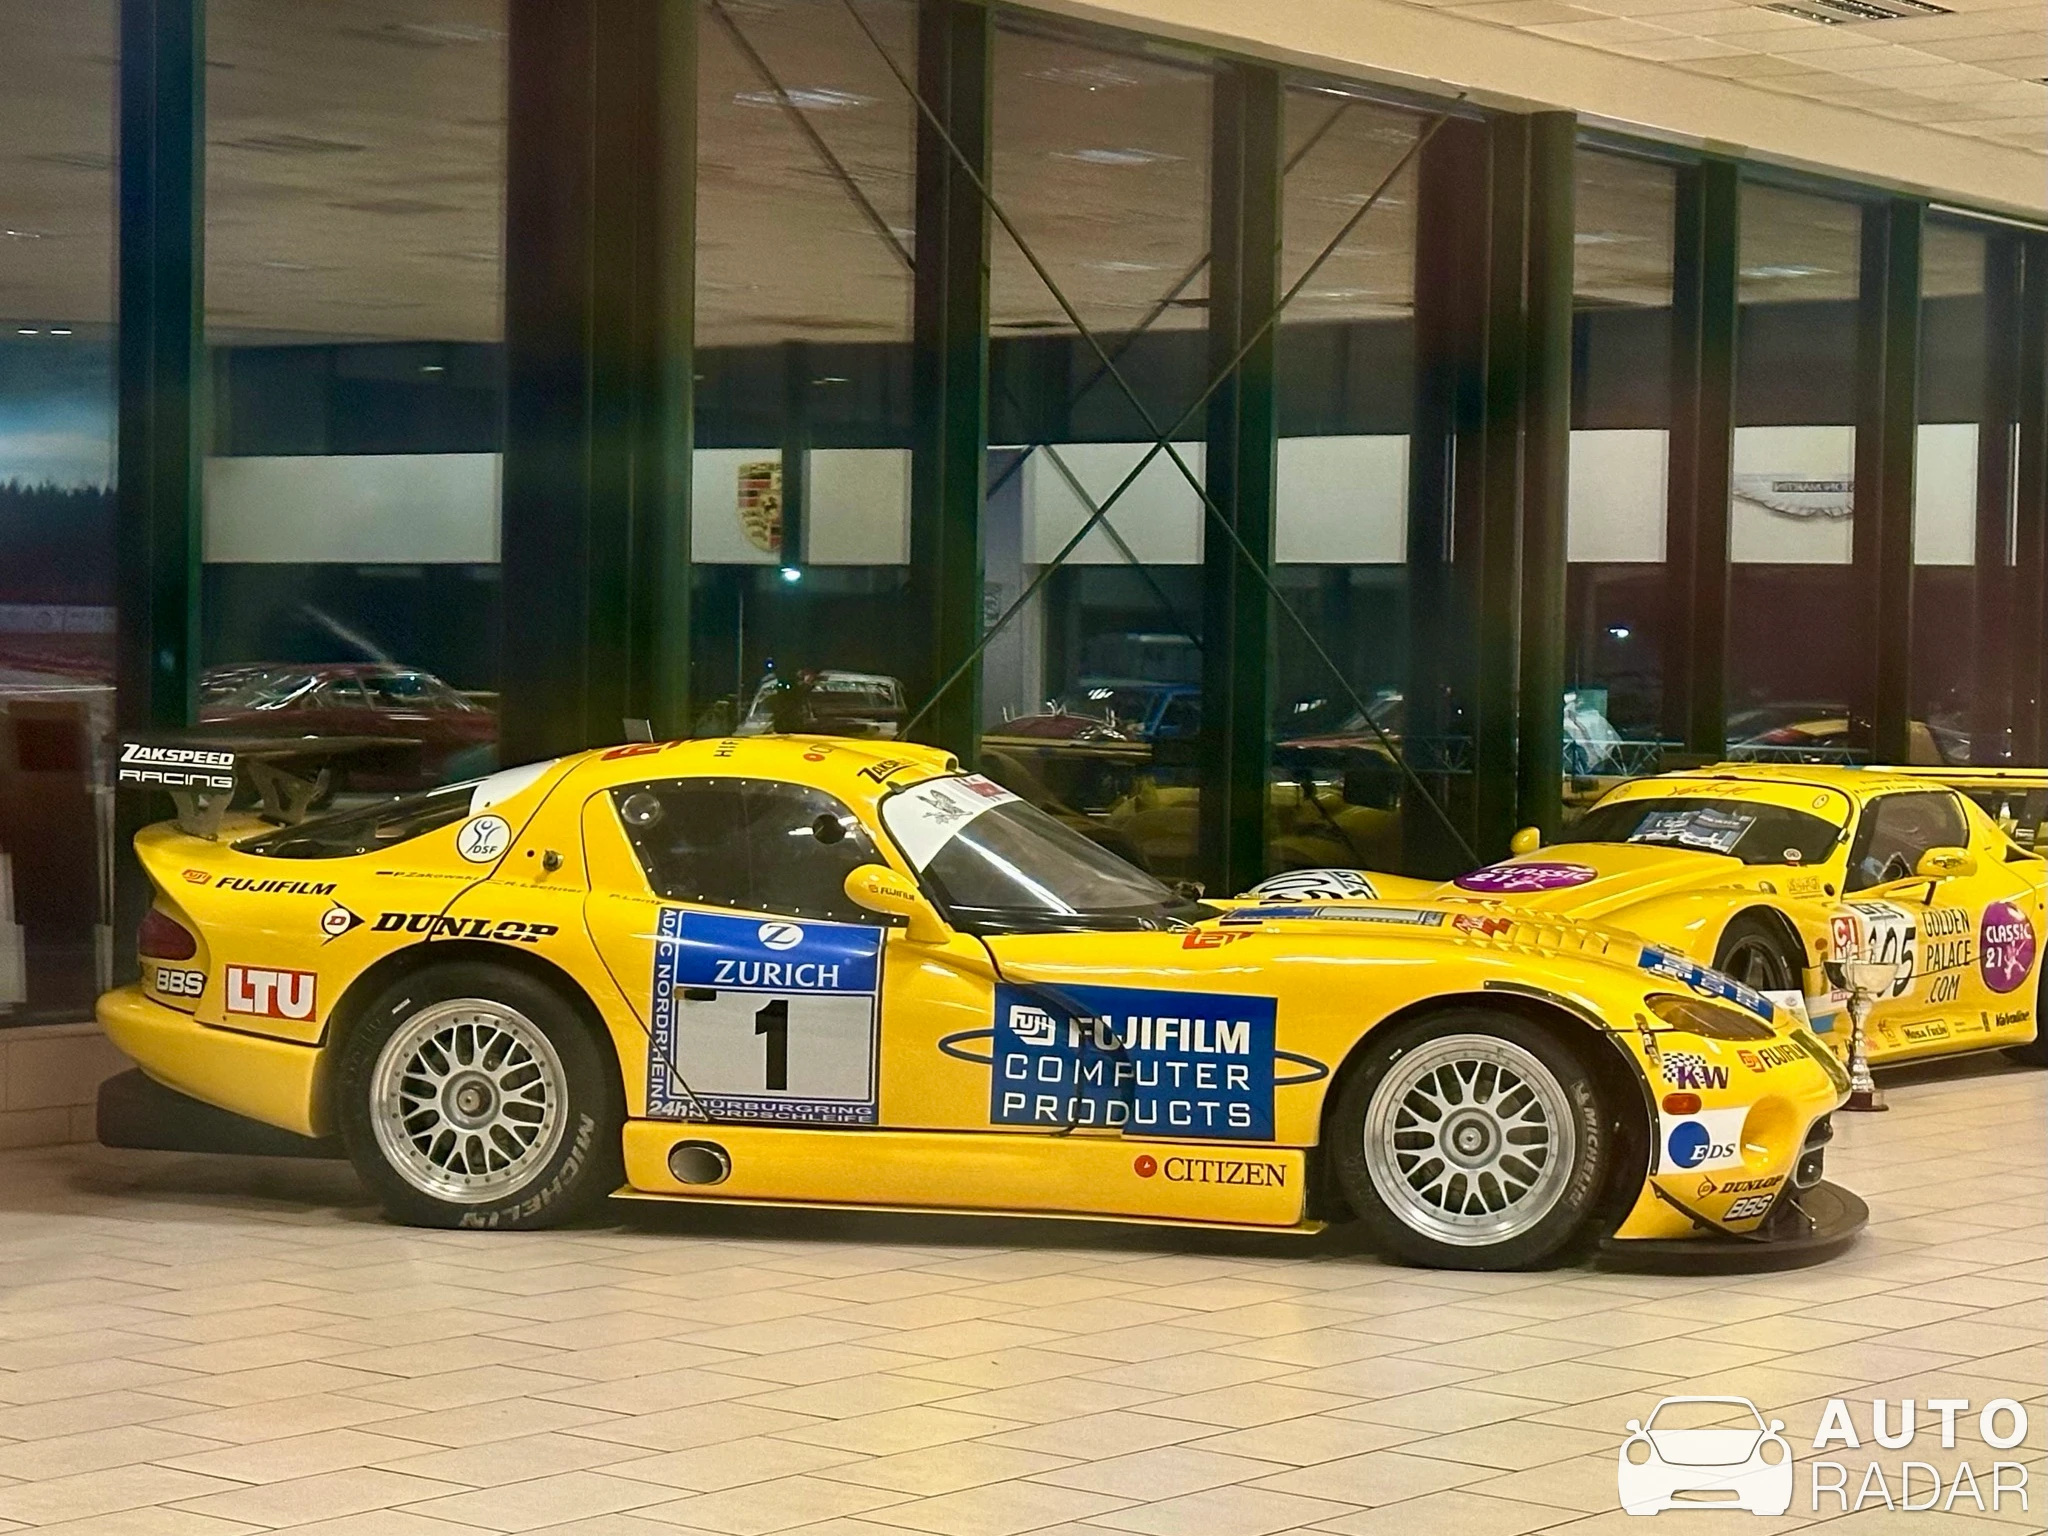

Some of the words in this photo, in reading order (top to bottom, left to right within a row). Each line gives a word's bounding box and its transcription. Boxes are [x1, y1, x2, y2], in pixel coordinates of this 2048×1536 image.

[121, 743, 235, 768] ZAKSPEED
[119, 769, 233, 788] RACING
[472, 845, 498, 854] DSF
[215, 877, 337, 895] FUJIFILM
[371, 912, 559, 943] DUNLOP
[659, 908, 677, 957] ADAC
[1921, 908, 1970, 938] GOLDEN
[1986, 922, 2032, 943] CLASSIC
[1926, 940, 1971, 972] PALACE
[1985, 947, 2003, 968] 21
[156, 969, 204, 996] BBS
[714, 959, 840, 988] ZURICH
[227, 967, 315, 1018] LTU
[1925, 974, 1960, 1004] .COM
[651, 964, 672, 1099] NORDRHEIN
[755, 1000, 788, 1091] 1
[1068, 1015, 1250, 1055] FUJIFILM
[1004, 1053, 1252, 1091] COMPUTER
[1677, 1065, 1729, 1090] KW
[648, 1100, 688, 1118] 24h
[689, 1099, 872, 1116] NÜRBURGRING
[688, 1108, 872, 1123] NORDSCHLEIFE
[1002, 1092, 1252, 1128] PRODUCTS
[1568, 1106, 1599, 1208] MICHELIN
[1689, 1142, 1736, 1161] EDS
[458, 1112, 595, 1228] MICHELIN
[1164, 1156, 1287, 1188] CITIZEN
[1719, 1174, 1785, 1194] DUNLOP
[1722, 1193, 1775, 1221] BBS
